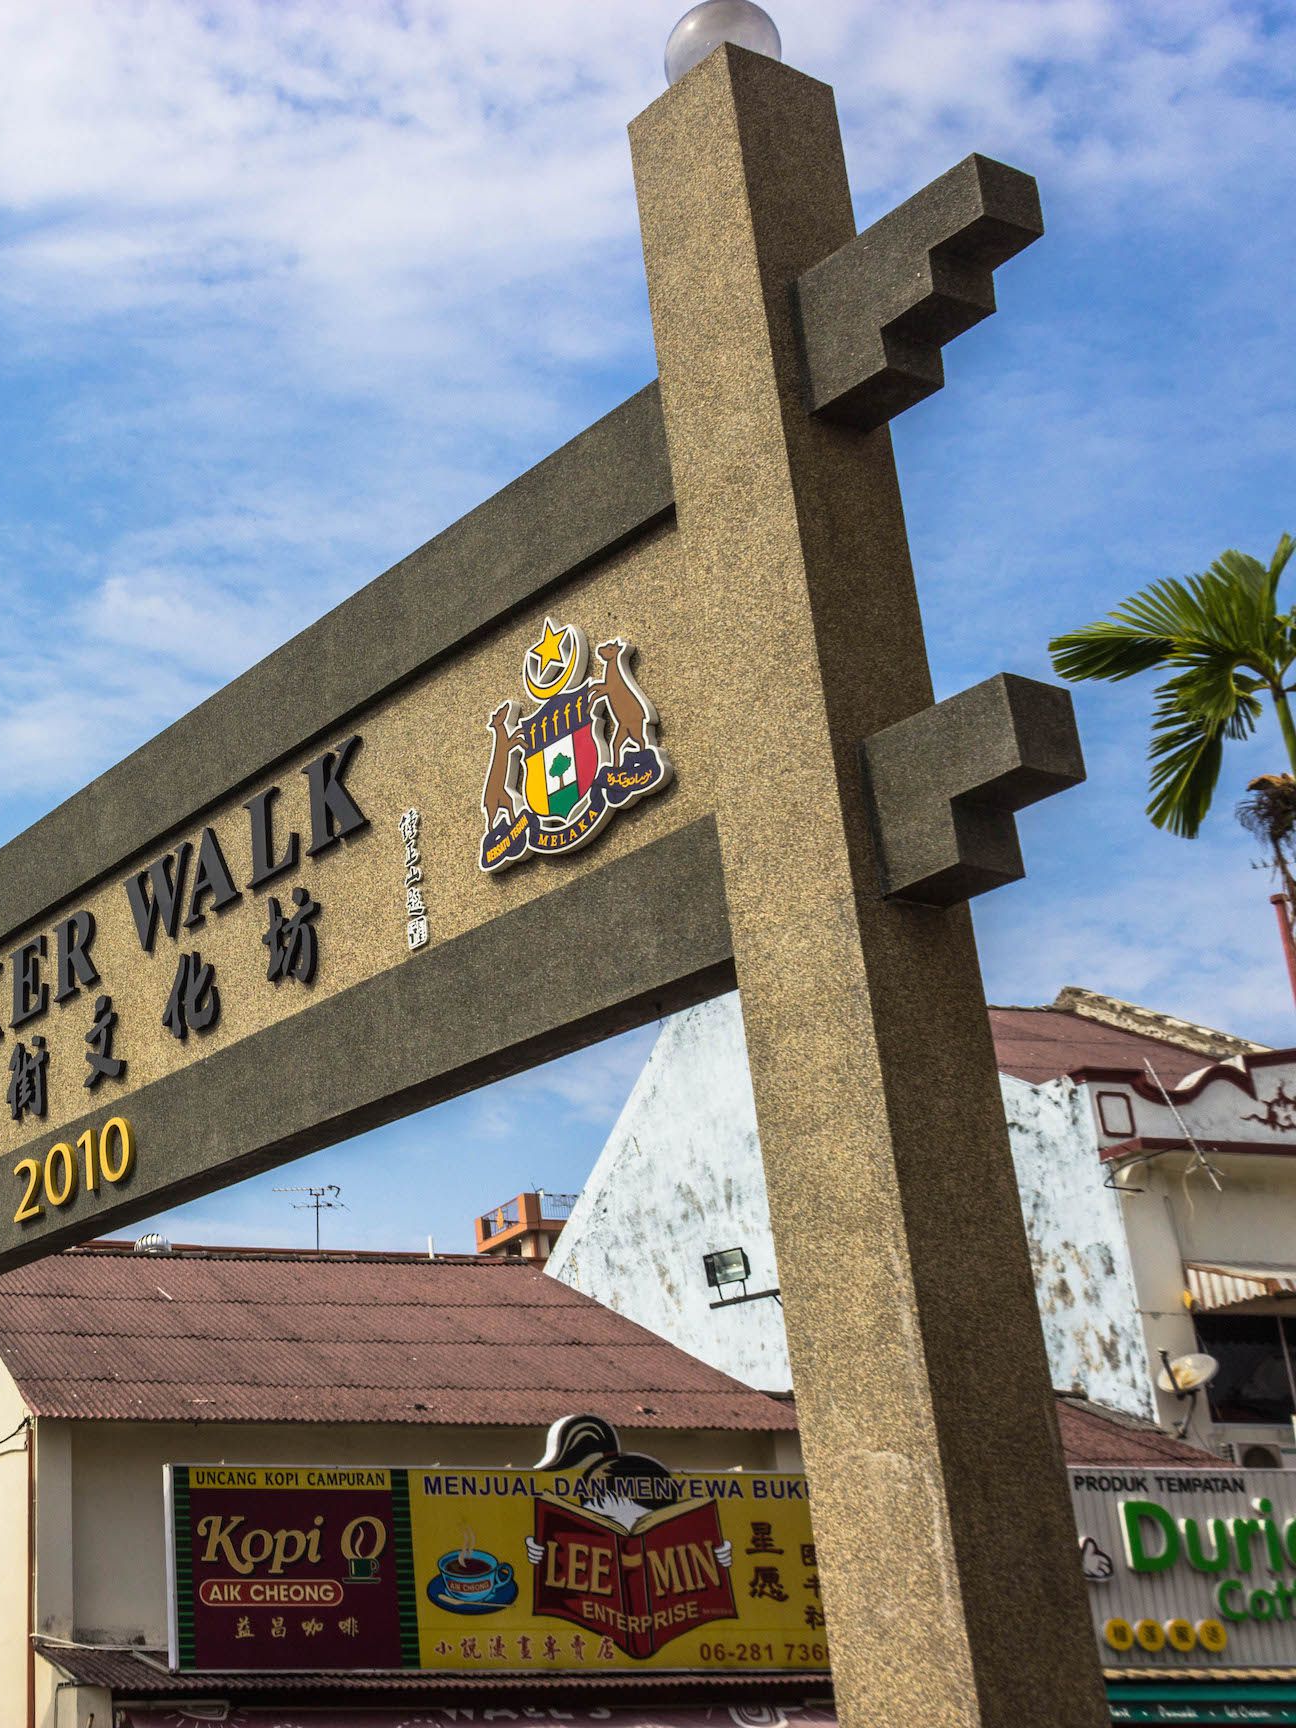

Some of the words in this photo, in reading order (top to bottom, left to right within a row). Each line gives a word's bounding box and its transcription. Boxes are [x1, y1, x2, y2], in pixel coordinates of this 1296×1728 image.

[123, 734, 371, 952] WALK
[486, 834, 511, 864] BERSATU
[510, 814, 529, 844] TEGUH
[538, 809, 599, 847] MELAKA
[13, 1116, 135, 1224] 2010
[196, 1471, 257, 1486] UNCANG
[265, 1472, 299, 1486] KOPI
[307, 1472, 386, 1487] CAMPURAN
[424, 1476, 544, 1496] MENJUAL
[555, 1477, 605, 1497] DAN
[615, 1476, 744, 1499] MENYEWA
[754, 1480, 809, 1499] BUK
[1074, 1476, 1148, 1492] PRODUK
[1155, 1476, 1246, 1493] TEMPATAN
[196, 1515, 324, 1575] Kopi
[1118, 1498, 1296, 1573] Duri
[545, 1540, 613, 1596] LEE
[647, 1540, 721, 1597] MIN
[209, 1584, 241, 1601] AIK
[249, 1584, 335, 1602] CHEONG
[1216, 1579, 1296, 1622] Cot
[235, 1615, 360, 1639] 益昌咖啡
[583, 1601, 699, 1633] ENTERPRISE
[700, 1643, 773, 1662] 06-281
